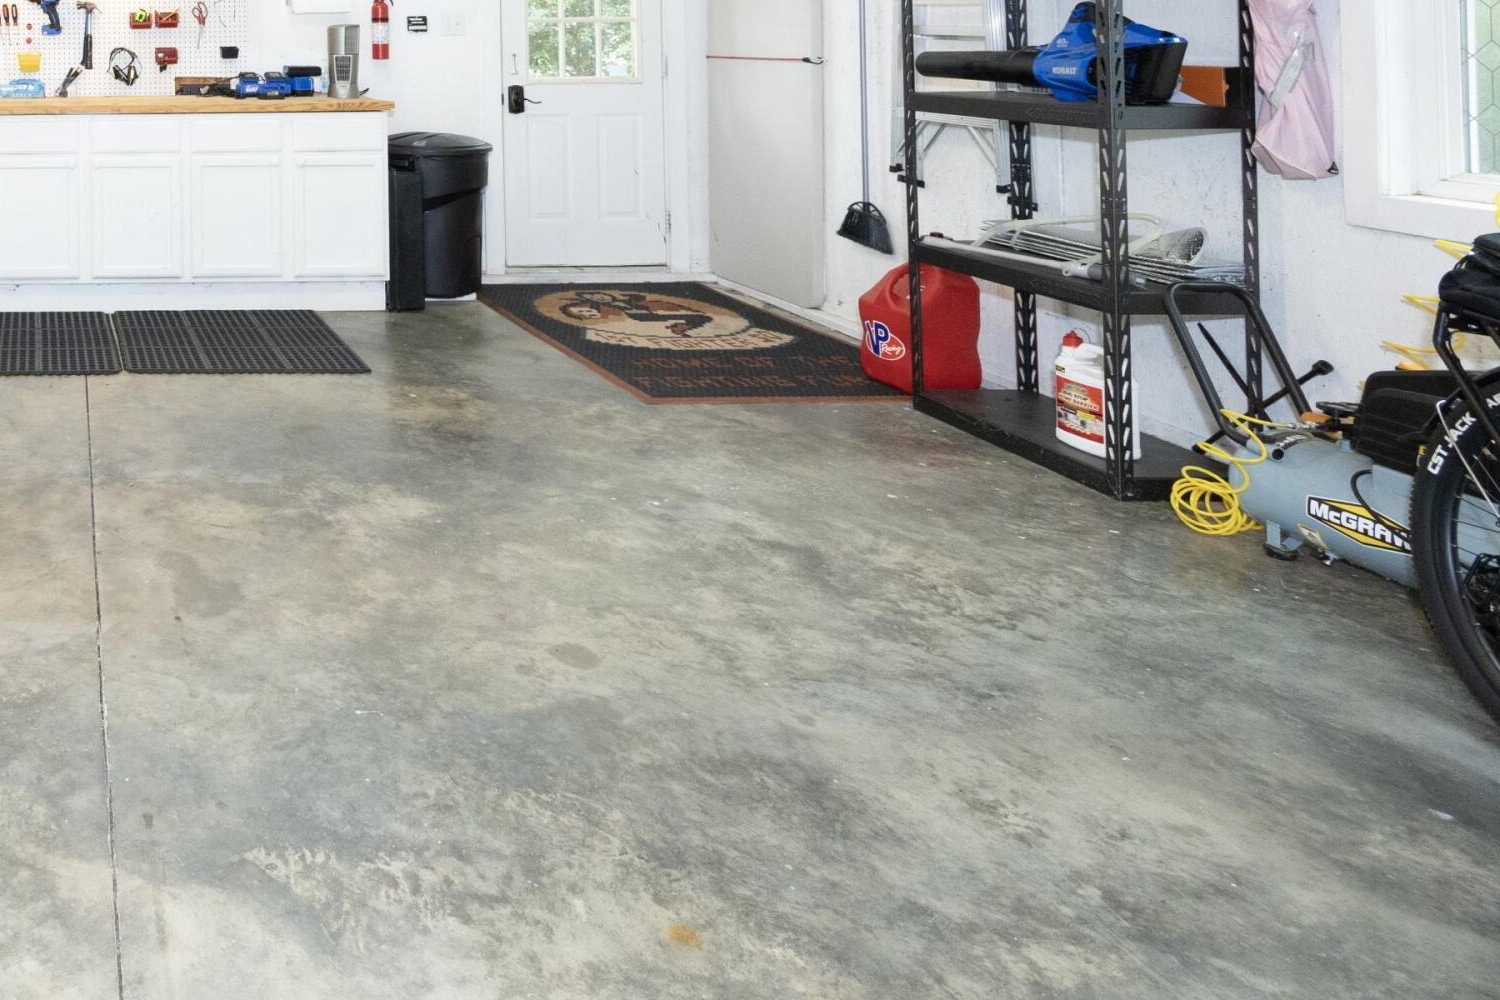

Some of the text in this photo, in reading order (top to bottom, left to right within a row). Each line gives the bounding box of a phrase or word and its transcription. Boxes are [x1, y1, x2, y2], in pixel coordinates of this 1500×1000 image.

[1052, 66, 1077, 76] KOBALT
[647, 335, 760, 349] FIGHTER
[864, 319, 891, 358] VP
[632, 356, 734, 369] HOME
[632, 375, 798, 388] FIGHTING
[1426, 444, 1449, 475] CST
